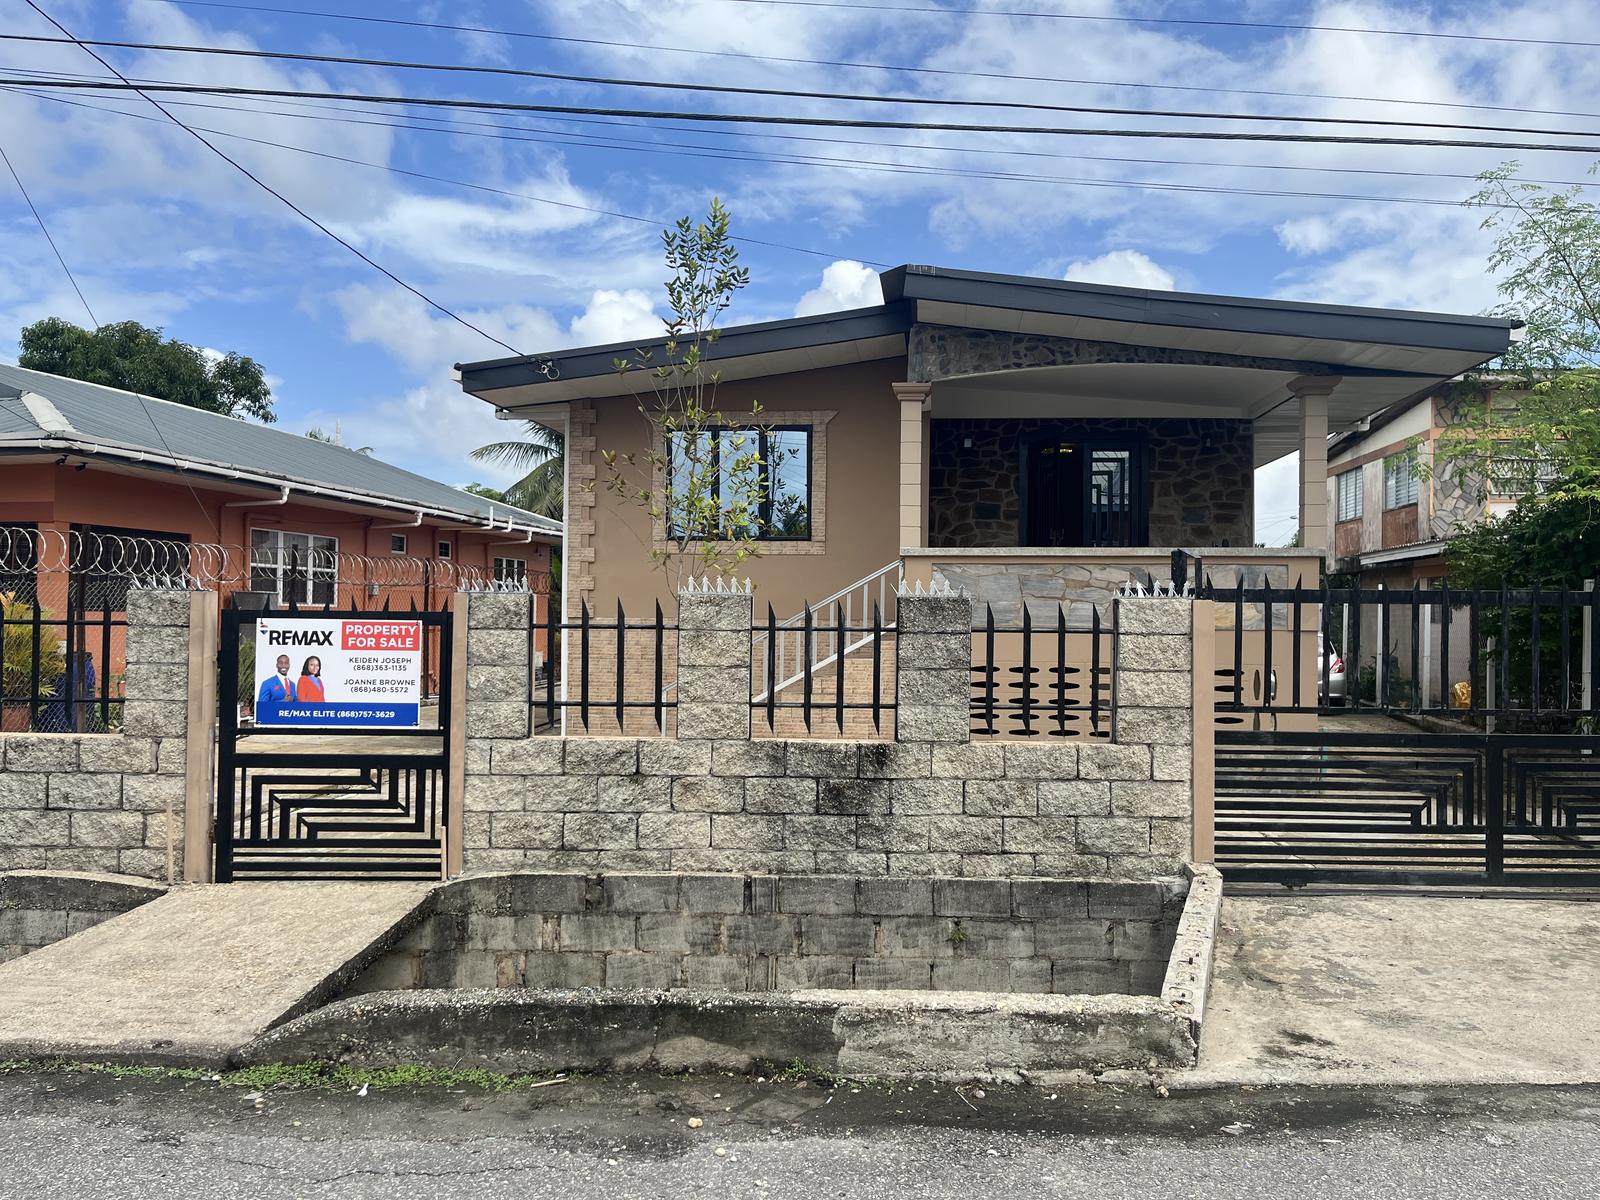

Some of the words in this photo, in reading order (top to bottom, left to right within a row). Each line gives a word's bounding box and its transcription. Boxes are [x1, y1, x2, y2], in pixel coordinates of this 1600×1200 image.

[345, 624, 417, 636] PROPERTY
[348, 637, 376, 648] FOR
[380, 638, 414, 648] SALE
[381, 657, 412, 665] JOSEPH
[350, 686, 409, 694] (868)480-5572
[337, 710, 395, 719] (868)757-3629
